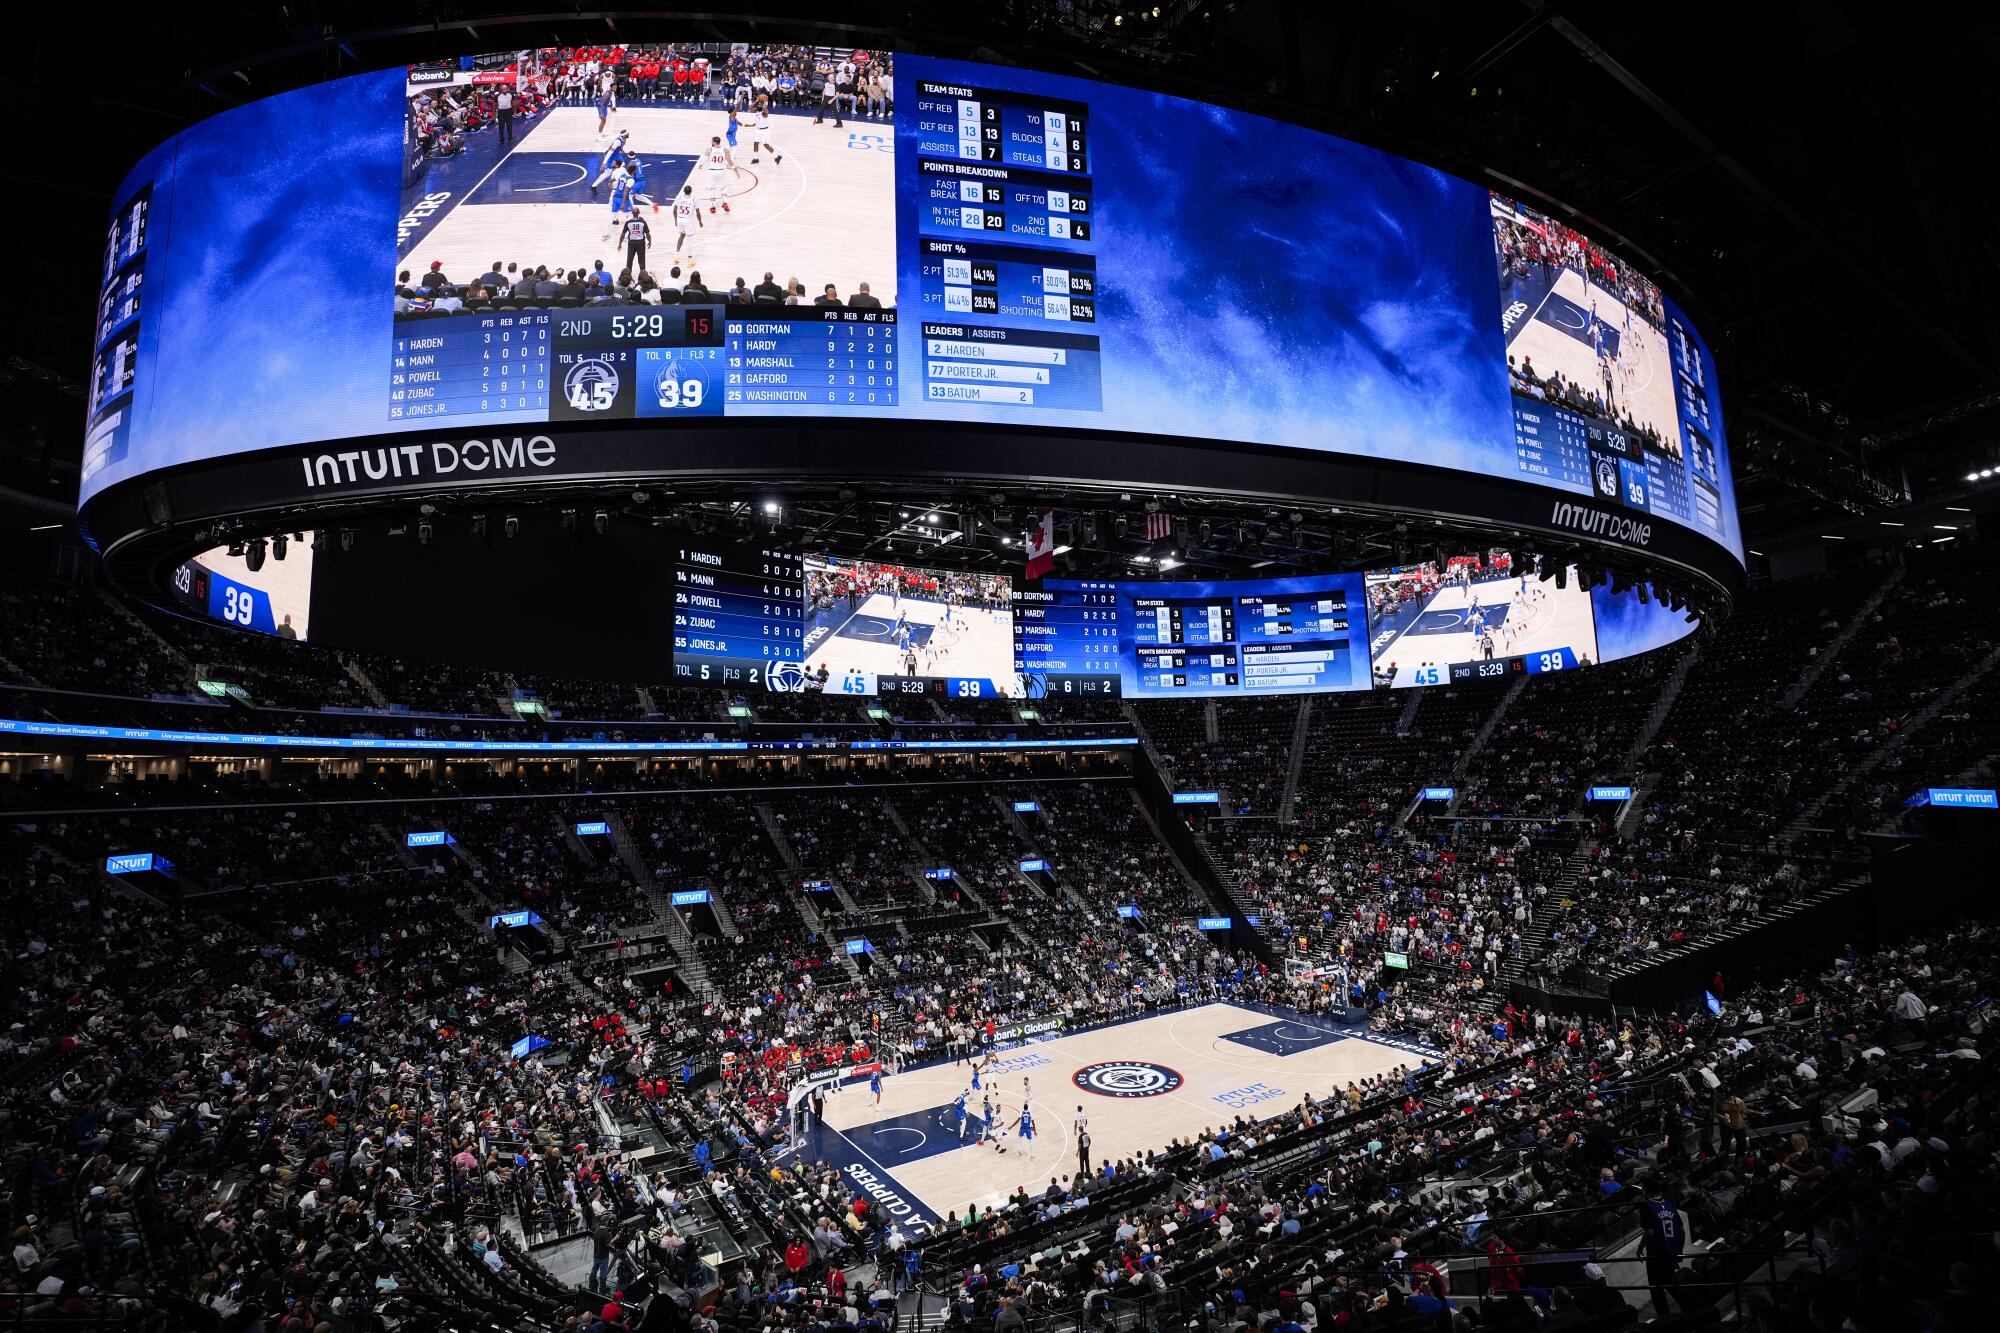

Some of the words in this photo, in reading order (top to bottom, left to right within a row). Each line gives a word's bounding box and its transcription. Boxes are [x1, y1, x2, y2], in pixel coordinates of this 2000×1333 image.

[411, 72, 445, 81] Globant
[924, 84, 947, 94] TEAM
[949, 86, 972, 97] STATS
[919, 102, 934, 111] OFF
[936, 104, 952, 113] REB
[1027, 115, 1040, 124] T/O
[1049, 118, 1061, 129] 10
[1070, 121, 1080, 131] 11
[920, 122, 935, 130] DEF
[938, 124, 954, 133] REB
[964, 126, 976, 136] 13
[986, 128, 998, 139] 13
[1012, 133, 1042, 144] BLOCKS
[920, 142, 954, 153] ASSISTS
[965, 146, 976, 156] 15
[711, 155, 724, 164] 40
[1013, 152, 1042, 163] STEALS
[924, 162, 954, 173] POINTS
[956, 165, 1008, 179] BREAKDOWN
[936, 180, 957, 189] FAST
[931, 190, 957, 199] BREAK
[966, 187, 977, 197] 16
[988, 190, 999, 200] 15
[1016, 194, 1031, 202] OFF
[1032, 195, 1045, 204] T/O
[1053, 198, 1064, 208] 13
[1072, 200, 1086, 210] 20
[680, 206, 690, 215] 55
[932, 207, 940, 215] IN
[942, 208, 959, 217] THE
[935, 217, 959, 226] PAINT
[966, 214, 980, 224] 28
[987, 216, 1002, 227] 20
[1028, 216, 1045, 225] 2ND
[1012, 225, 1046, 235] CHANCE
[930, 243, 952, 252] SHOT
[974, 270, 994, 282] 44.1%
[974, 297, 995, 309] 28.6%
[1022, 296, 1042, 306] TRUE
[824, 312, 837, 320] PTS
[844, 313, 857, 321] REB
[864, 313, 876, 321] AST
[882, 314, 894, 322] FLS
[1000, 306, 1043, 317] SHOOTING
[1073, 306, 1092, 317] 53.2%
[501, 318, 512, 326] REB
[537, 316, 548, 324] FLS
[561, 320, 591, 337] 2ND
[612, 314, 663, 338] 5:29
[691, 318, 708, 334] 15
[728, 324, 742, 334] 00
[746, 324, 790, 334] GORTMAN
[925, 326, 963, 336] LEADERS
[972, 329, 1005, 339] ASSISTS
[410, 338, 443, 350] HARDEN
[746, 341, 776, 350] HARDY
[646, 352, 660, 360] TOL
[690, 351, 703, 359] FLS
[947, 345, 984, 356] HARDEN
[409, 355, 434, 366] MANN
[559, 354, 573, 363] TOL
[601, 353, 614, 361] FLS
[729, 358, 741, 367] 13
[746, 357, 794, 367] MARSHALL
[393, 375, 404, 384] 24
[409, 371, 441, 383] POWELL
[932, 365, 944, 375] 77
[947, 366, 982, 377] PORTER
[984, 368, 998, 379] JR.
[729, 374, 741, 384] 21
[746, 374, 787, 384] GAFFORD
[408, 387, 434, 399] ZUBAC
[570, 382, 612, 410] 45
[659, 379, 702, 408] 39
[728, 391, 741, 401] 25
[746, 391, 807, 401] WASHINGTON
[932, 386, 945, 396] 33
[948, 387, 980, 398] BATUM
[391, 407, 402, 417] 55
[407, 404, 432, 416] JONES
[434, 403, 447, 413] JR.
[1589, 427, 1601, 440] 2ND
[1607, 431, 1626, 452] 5:29
[1600, 473, 1616, 496] 45
[1629, 483, 1644, 505] 39
[691, 552, 721, 565] HARDEN
[677, 572, 686, 581] 14
[690, 574, 714, 586] MANN
[197, 580, 205, 598] 15
[676, 593, 688, 603] 24
[691, 595, 721, 608] POWELL
[1024, 592, 1053, 601] GORTMAN
[224, 586, 253, 625] 39
[1025, 610, 1044, 618] HARDY
[675, 615, 687, 625] 24
[690, 617, 715, 628] ZUBAC
[675, 635, 686, 645] 55
[690, 639, 714, 650] JONES
[716, 642, 728, 651] JR.
[1026, 644, 1053, 652] GAFFORD
[676, 664, 692, 676] TOL
[701, 665, 710, 679] 5
[726, 669, 740, 679] FLS
[750, 669, 758, 683] 2
[1415, 668, 1438, 685] 45
[1455, 668, 1470, 678] 2ND
[1479, 663, 1504, 677] 5:29
[1540, 652, 1563, 672] 39
[843, 676, 865, 694] 45
[882, 681, 895, 690] 2ND
[902, 681, 924, 693] 5:29
[958, 681, 980, 697] 39
[1064, 681, 1072, 692] 6
[1104, 681, 1111, 692] 2
[1024, 1021, 1057, 1034] Globant
[1366, 1035, 1447, 1058] CLIPPERS
[810, 1068, 834, 1080] Globant
[1116, 1076, 1178, 1096] CLIPPERS
[844, 1163, 912, 1215] CLIPPERS
[1662, 1220, 1674, 1237] 13
